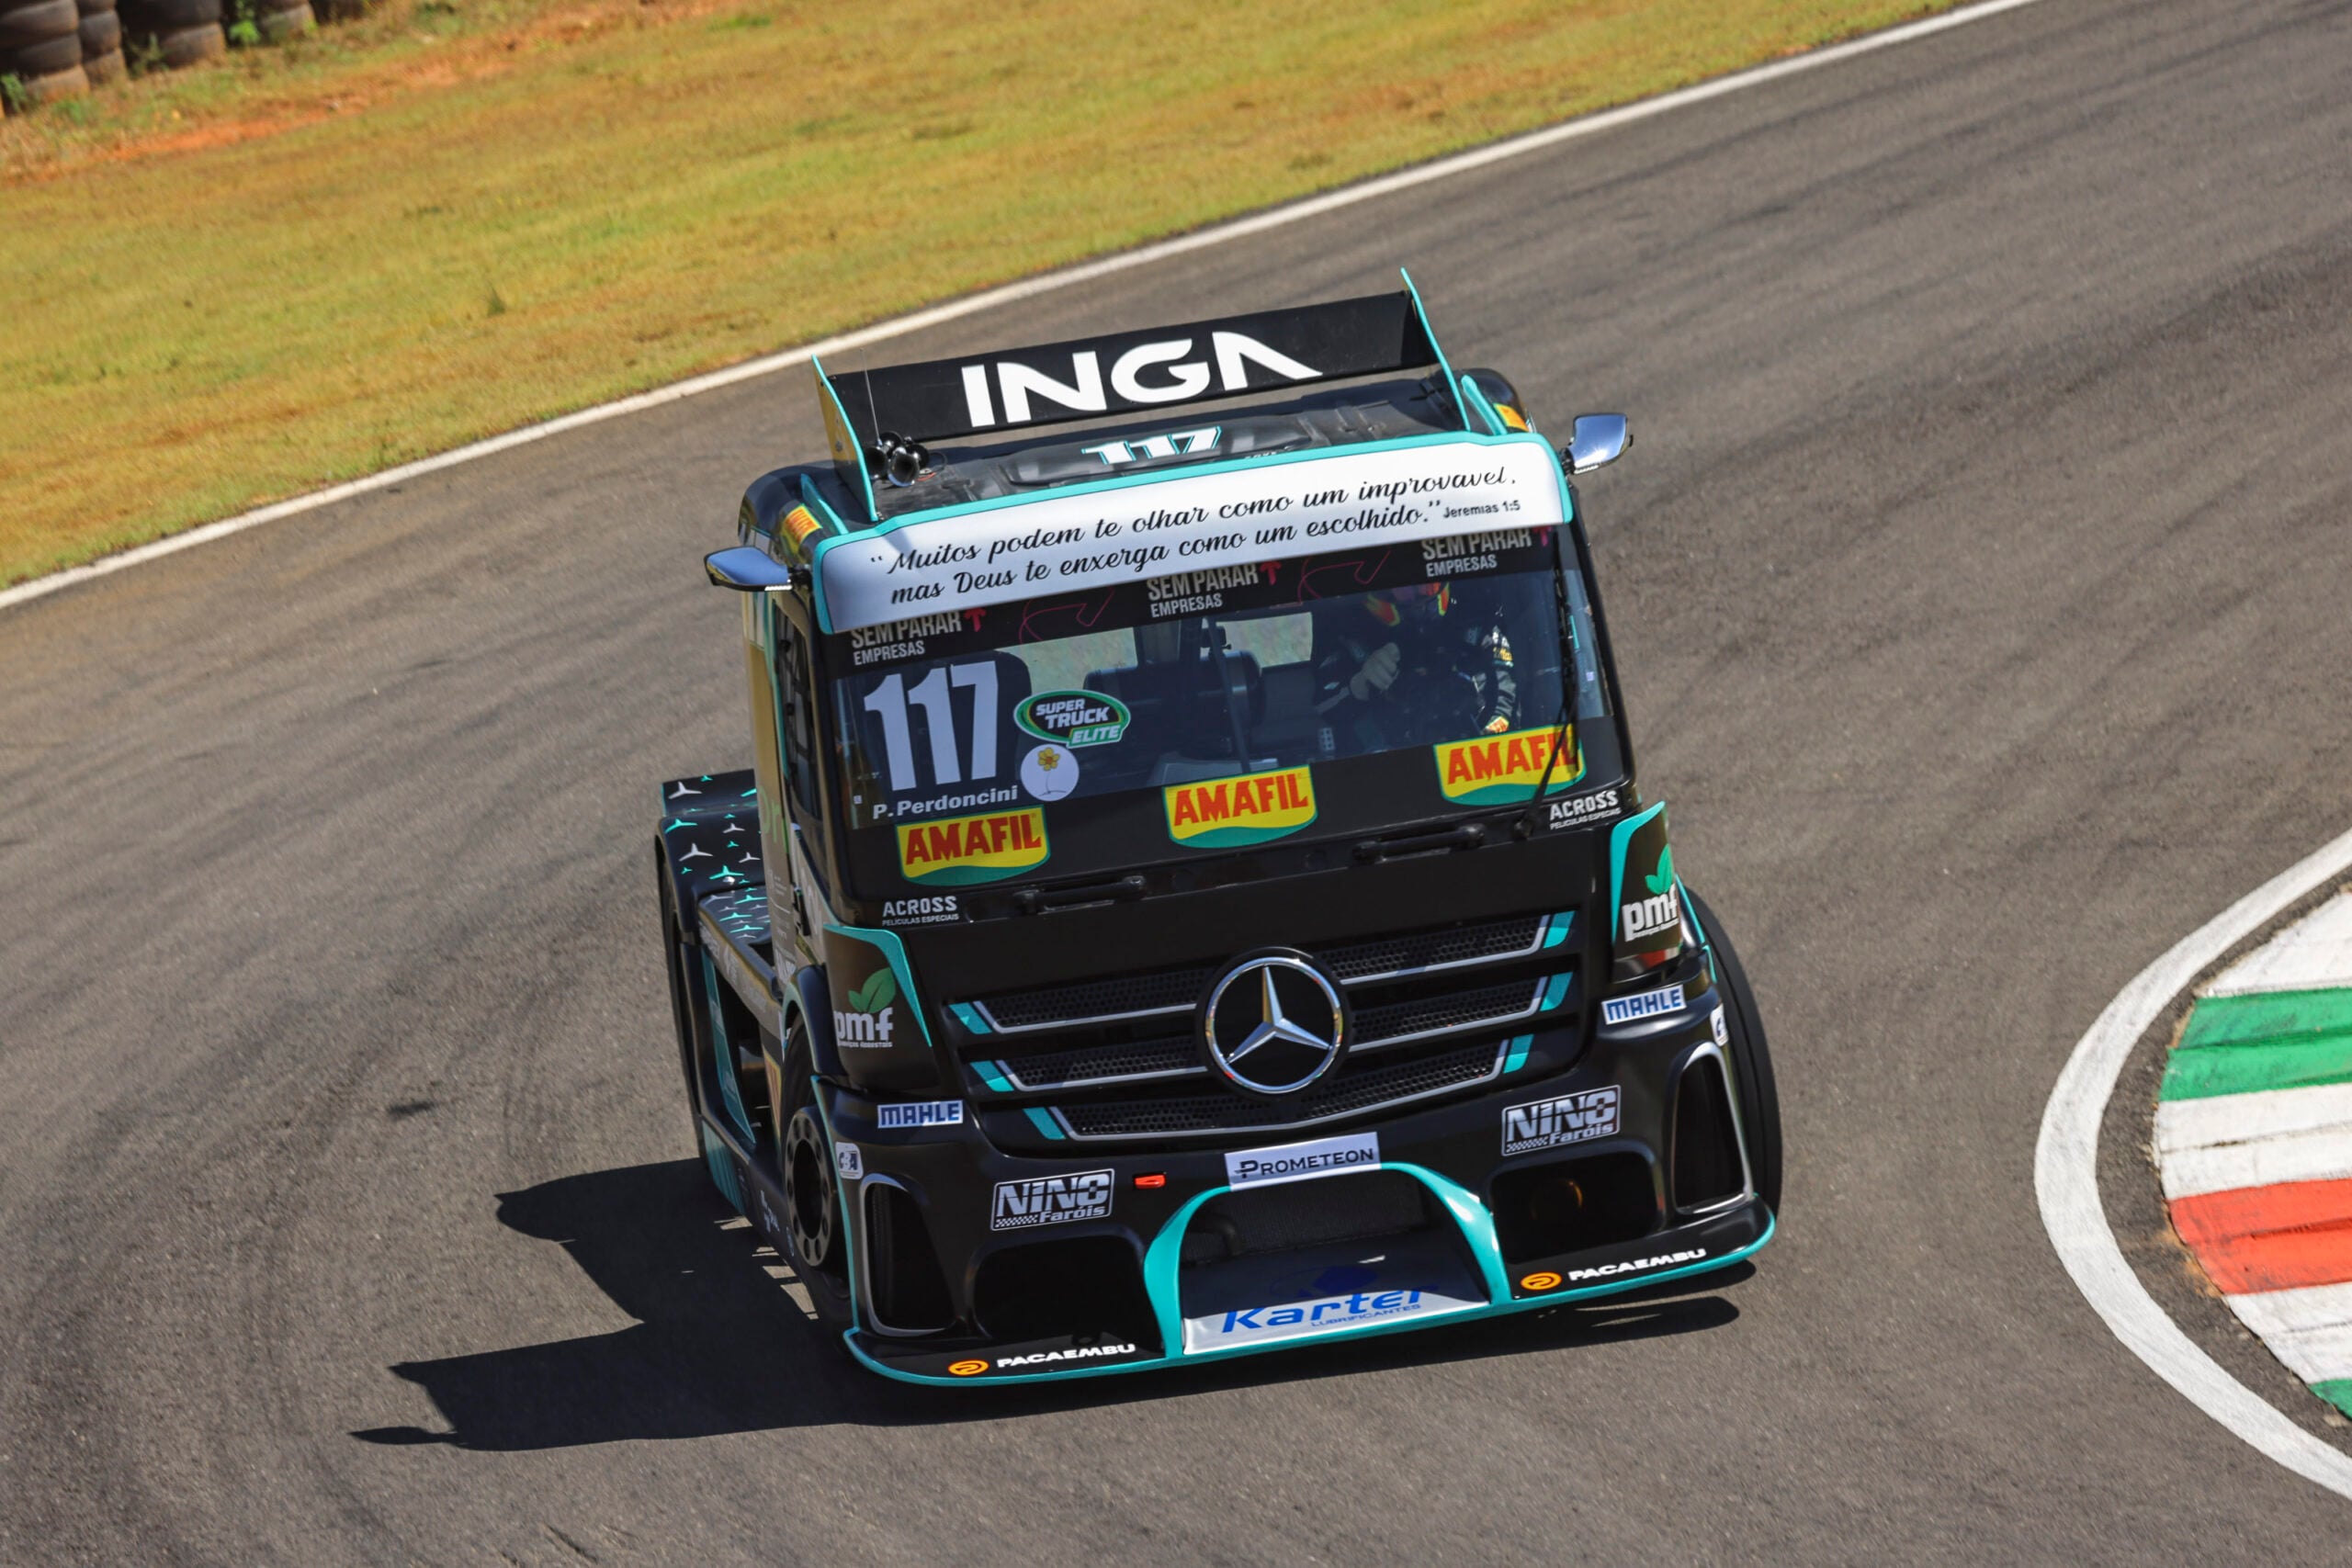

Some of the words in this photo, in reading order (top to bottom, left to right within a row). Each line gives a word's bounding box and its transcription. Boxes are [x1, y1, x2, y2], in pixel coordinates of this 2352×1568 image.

[961, 332, 1323, 427] INGA
[1080, 425, 1222, 465] 117
[989, 528, 1086, 564] podem
[1095, 517, 1122, 540] te
[1132, 506, 1209, 534] olhar
[1219, 494, 1295, 520] como
[1302, 488, 1350, 508] um
[890, 582, 945, 605] mas
[954, 570, 1017, 593] Deus
[1025, 558, 1051, 582] te
[1060, 543, 1170, 574] enxerga
[1179, 532, 1247, 557] como
[1255, 524, 1297, 546] um
[1442, 502, 1498, 519] Jeremias
[1502, 499, 1521, 513] 1:5
[1420, 534, 1465, 561] SEM
[1470, 527, 1532, 554] PARAR
[1426, 554, 1498, 578] EMPRESAS
[1147, 571, 1192, 602] SEM
[1193, 564, 1259, 594] PARAR
[1150, 592, 1223, 618] EMPRESAS
[851, 621, 894, 649] SEM
[896, 611, 962, 641] PARAR
[854, 640, 925, 666] EMPRESAS
[1035, 698, 1086, 716] SUPER
[1045, 706, 1110, 729] TRUCK
[864, 660, 998, 792] 117
[1070, 725, 1121, 745] ELITE
[1448, 728, 1578, 784] AMAFIL
[1174, 773, 1308, 827] AMAFIL
[1549, 789, 1619, 820] ACROSS
[906, 814, 1042, 865] AMAFIL
[882, 896, 957, 917] ACROSS
[1622, 882, 1678, 942] pmf
[1606, 988, 1681, 1021] MAHLE
[833, 1007, 893, 1044] pmf
[880, 1102, 960, 1126] MAHLE
[1548, 1122, 1614, 1145] Faróis
[1039, 1205, 1106, 1224] Faróis
[1567, 1248, 1707, 1281] PACAEMBU
[1311, 1303, 1422, 1328] LUBRIFICANTES
[997, 1343, 1136, 1368] PACAEMBU
